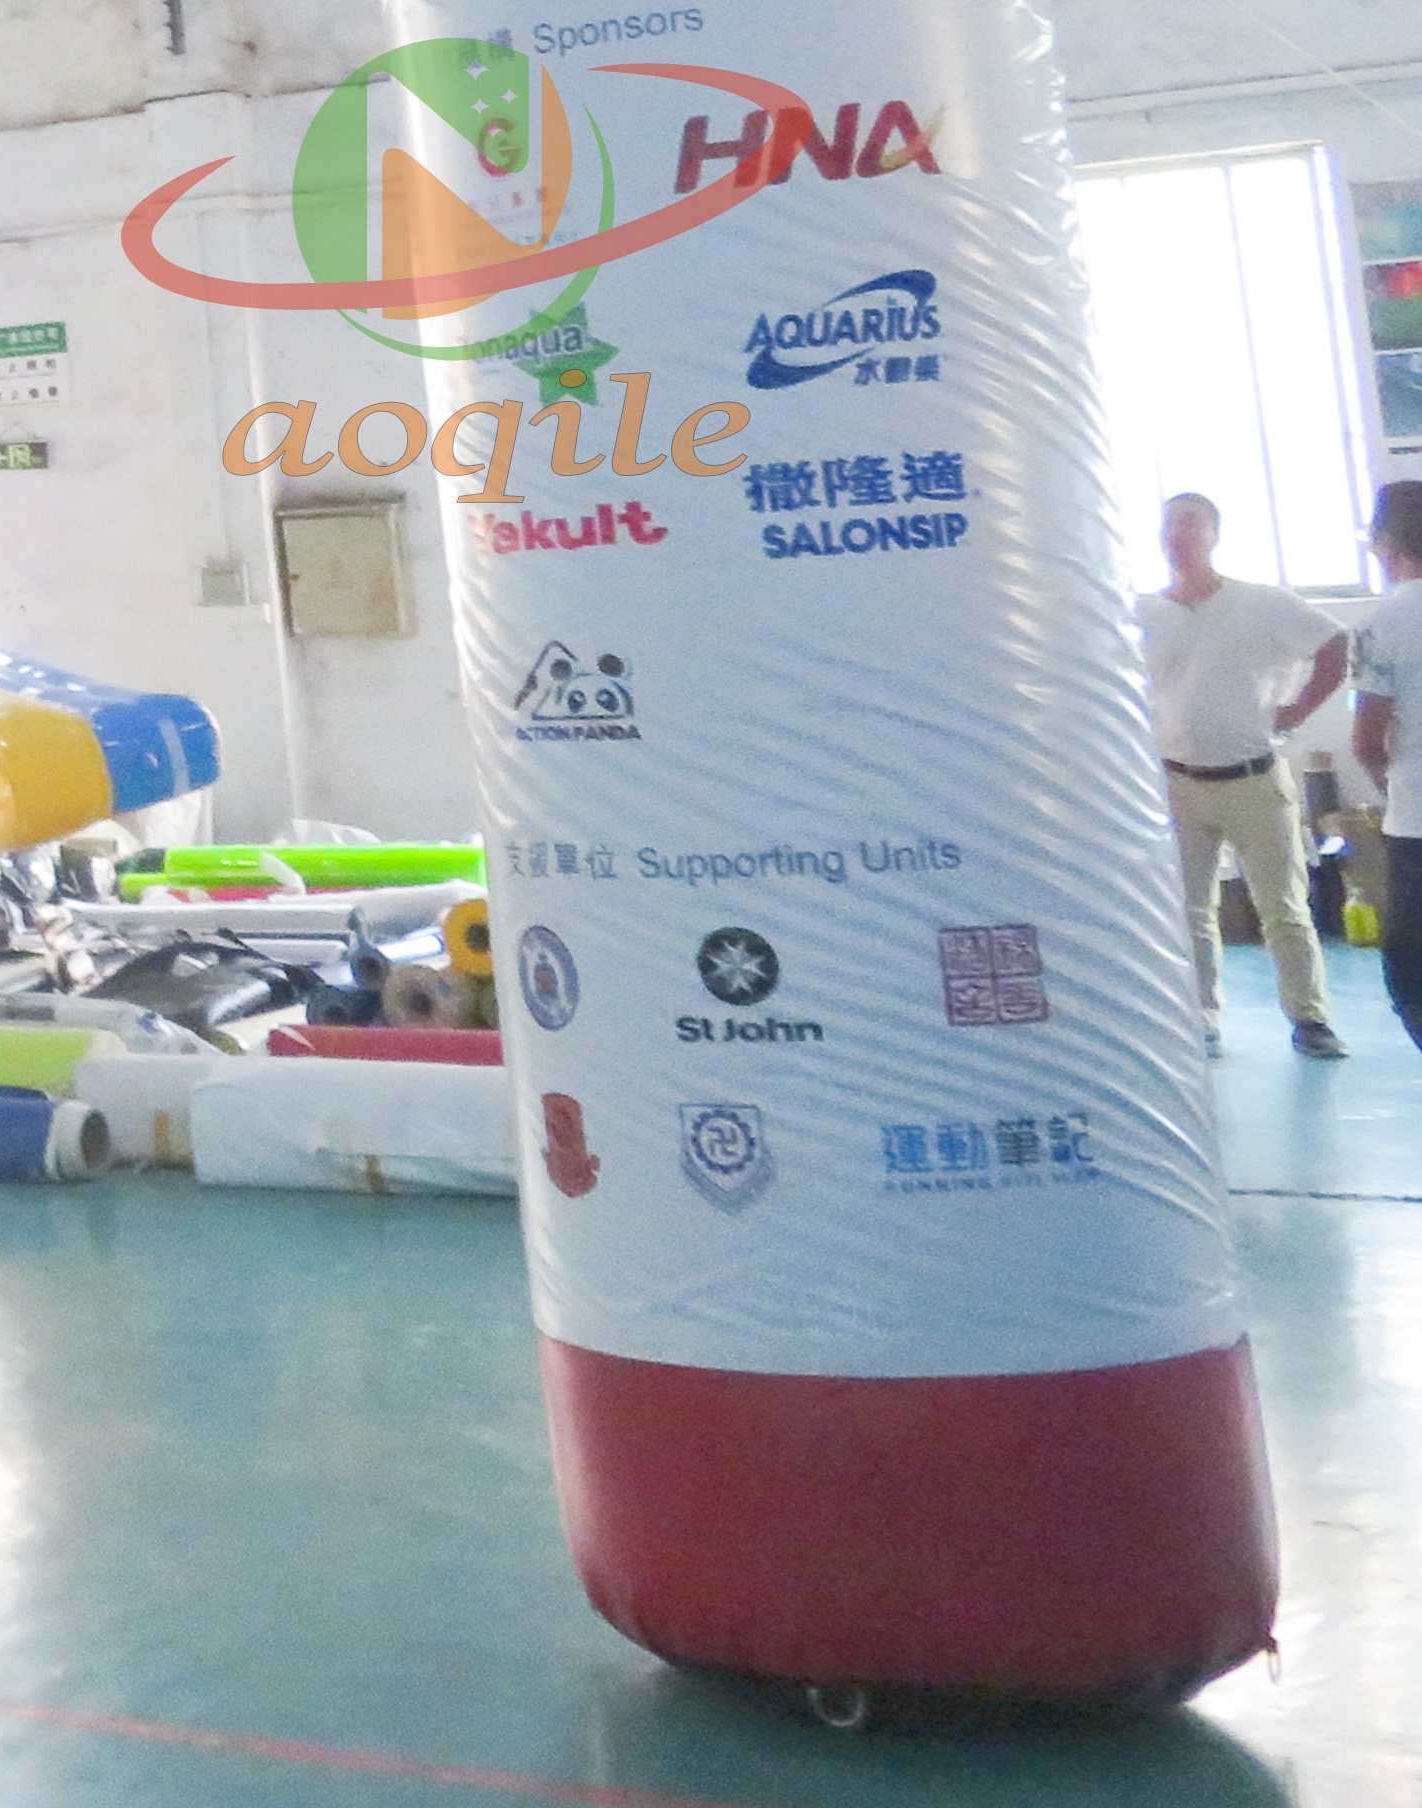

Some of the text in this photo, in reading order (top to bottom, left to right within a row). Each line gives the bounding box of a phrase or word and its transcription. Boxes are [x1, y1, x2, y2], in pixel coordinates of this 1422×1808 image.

[533, 8, 703, 57] Sponsors
[674, 100, 943, 194] HNA
[744, 302, 941, 352] AQUARIUS
[762, 512, 969, 560] SALONSIP
[636, 839, 962, 886] Supporting Units
[675, 1016, 824, 1044] St John
